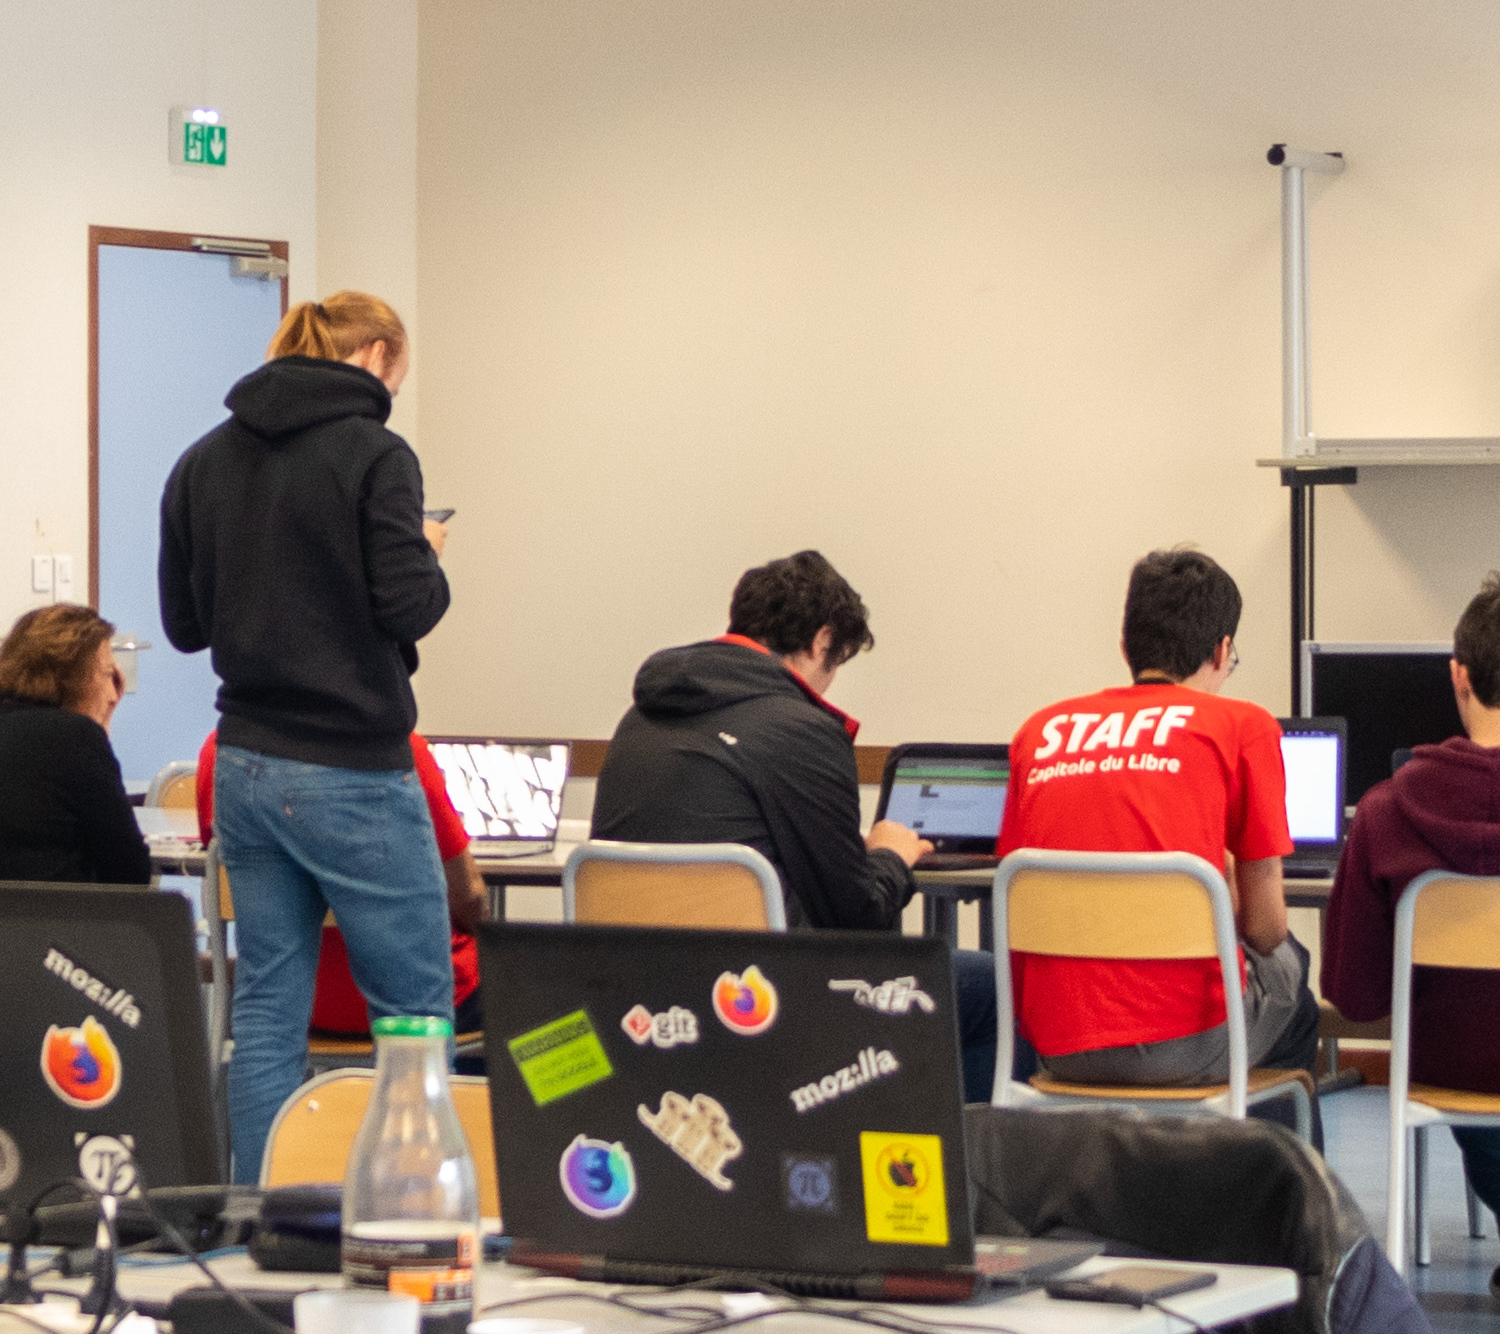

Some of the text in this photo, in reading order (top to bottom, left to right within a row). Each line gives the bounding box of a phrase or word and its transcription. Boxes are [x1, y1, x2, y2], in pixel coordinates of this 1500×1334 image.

[1034, 704, 1195, 760] STAFF
[1027, 752, 1181, 785] Capitole du Libre
[656, 1004, 693, 1041] git
